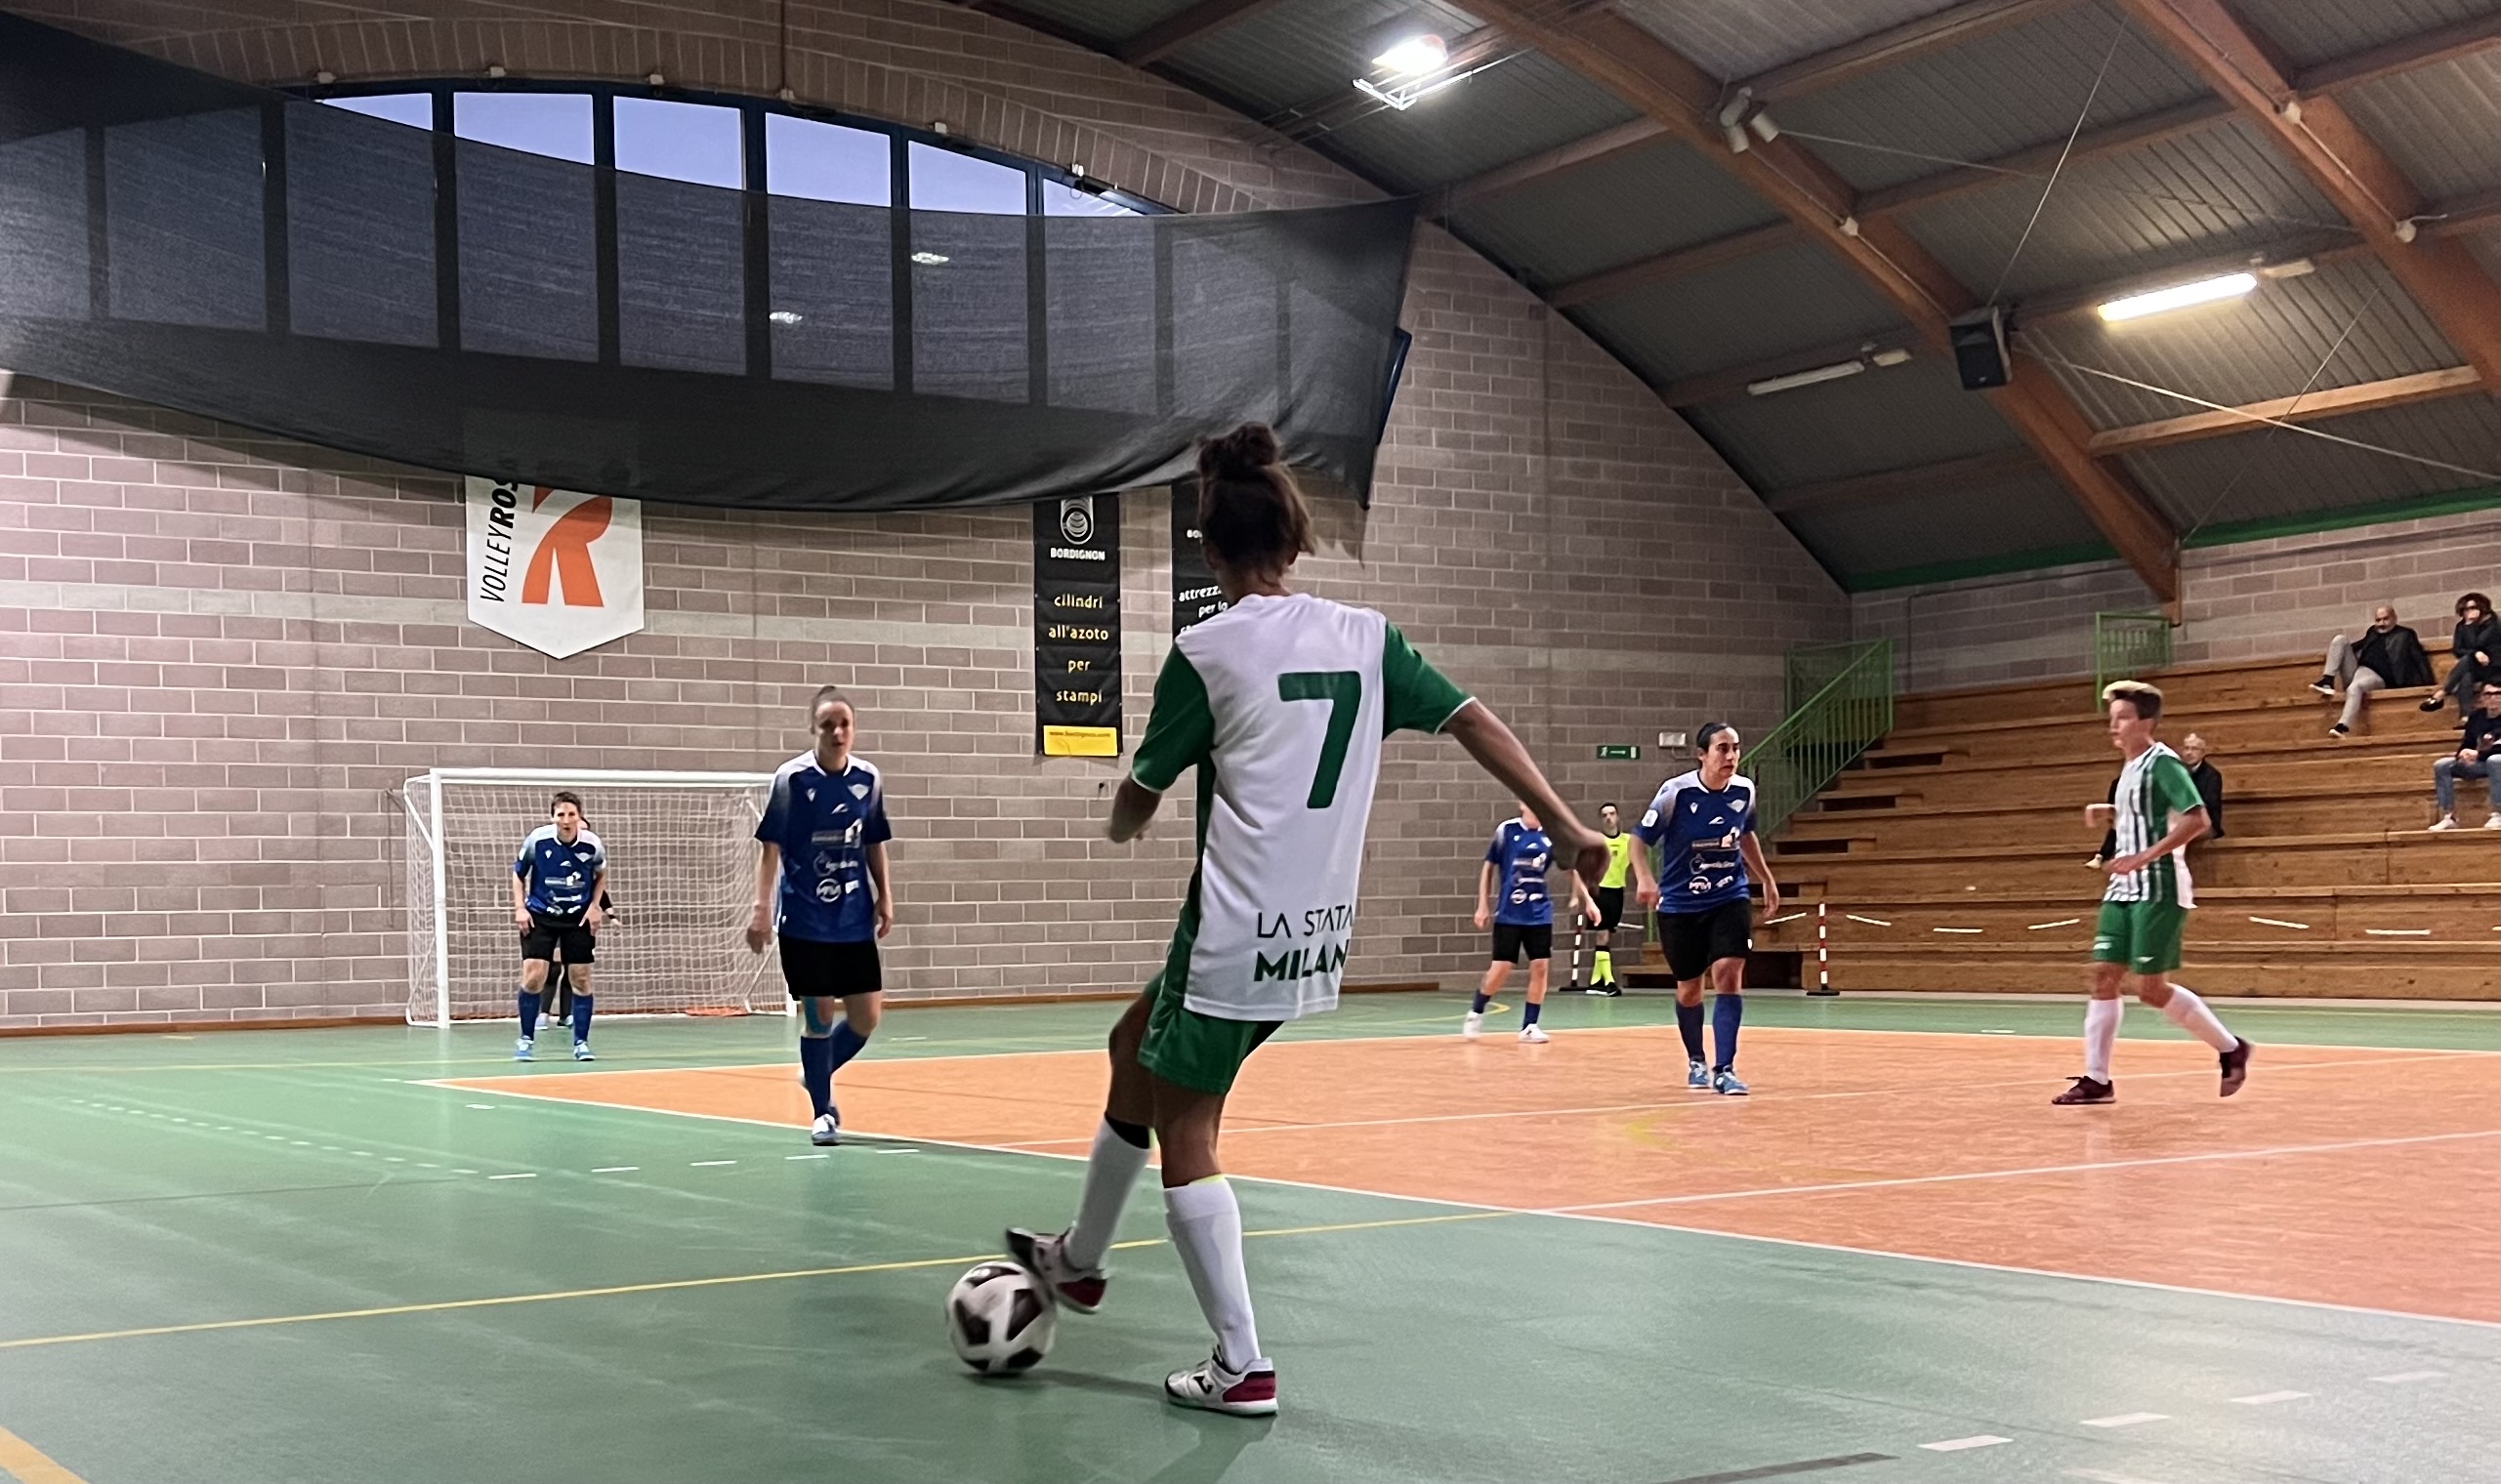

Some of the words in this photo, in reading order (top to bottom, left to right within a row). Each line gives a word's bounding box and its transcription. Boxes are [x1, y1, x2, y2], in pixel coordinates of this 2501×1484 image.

[1186, 529, 1203, 538] BO
[1050, 547, 1105, 561] BORDIGNON
[1054, 593, 1103, 609] cilindri
[1198, 604, 1216, 619] per
[1048, 624, 1108, 640] all'azoto
[1067, 660, 1091, 674] per
[1056, 689, 1103, 706] stampi
[1277, 671, 1361, 809] 7
[1257, 912, 1292, 938] LA
